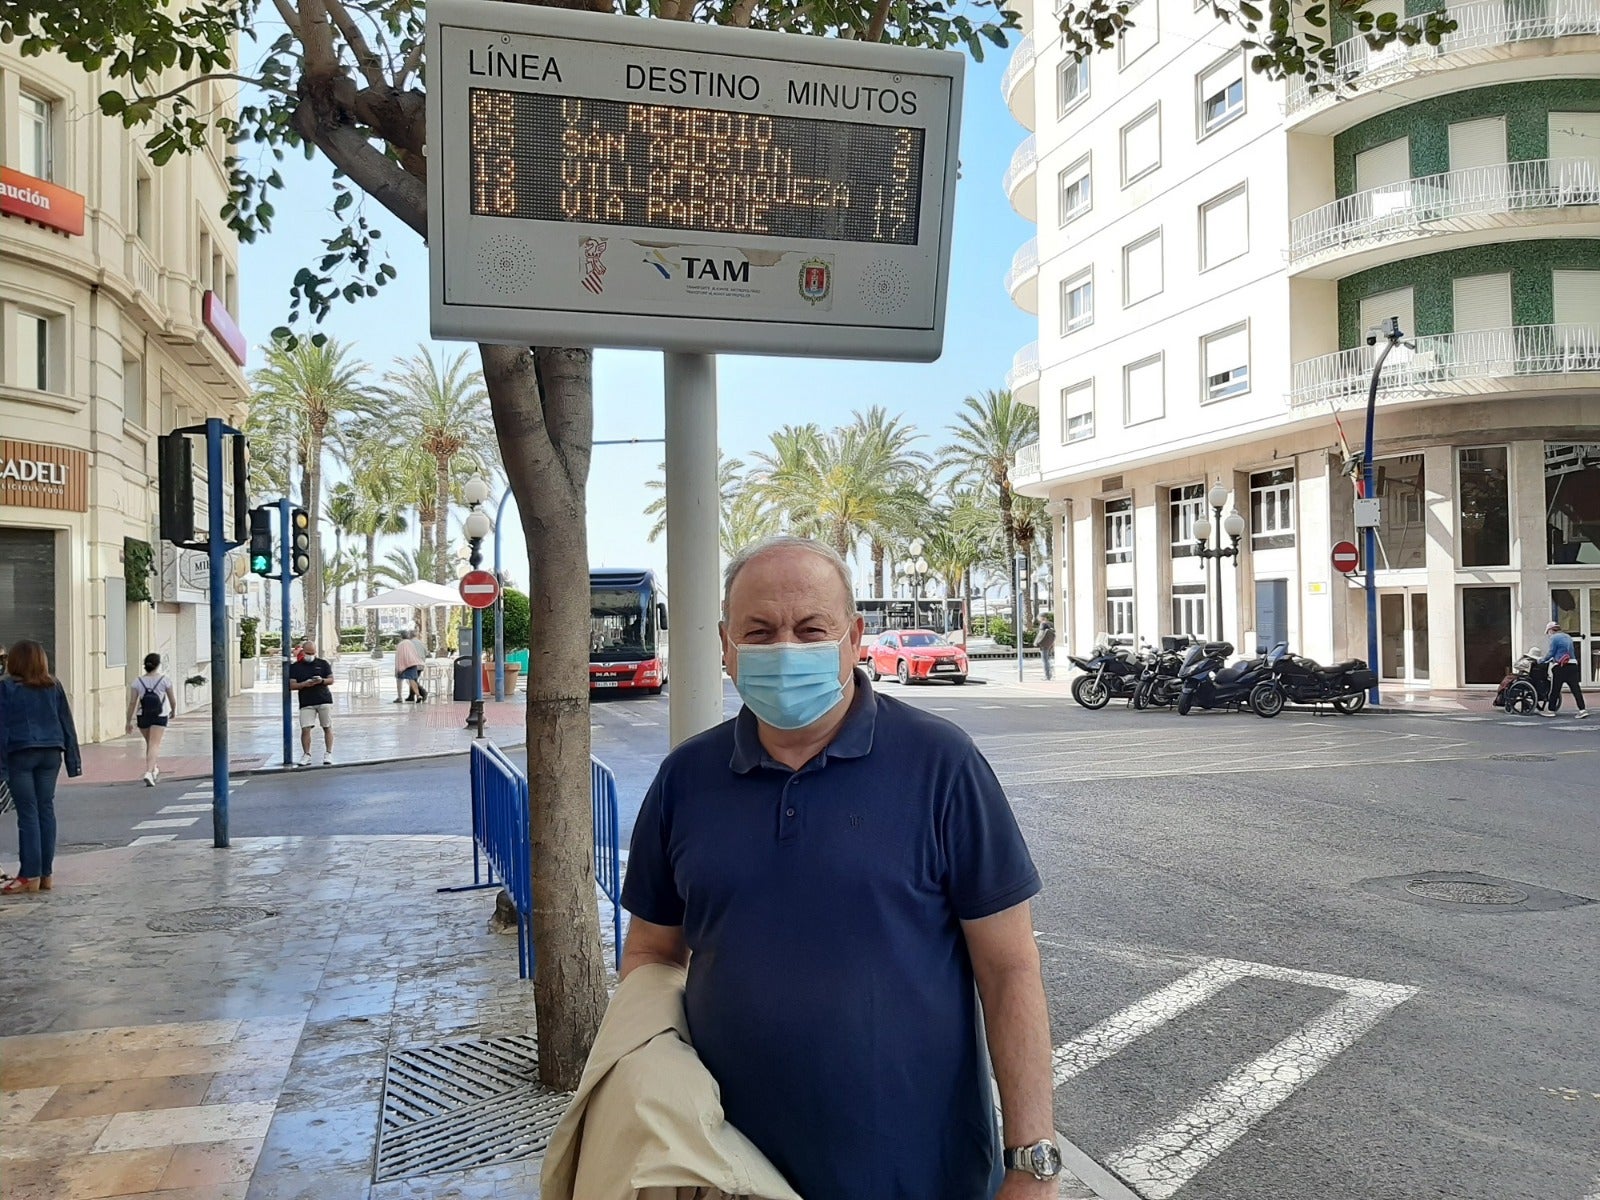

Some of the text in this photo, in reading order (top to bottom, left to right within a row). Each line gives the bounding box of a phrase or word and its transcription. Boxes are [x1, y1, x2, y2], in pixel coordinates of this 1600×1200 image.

[468, 44, 918, 116] LÍNEA DESTINO MINUTOS
[628, 104, 774, 144] REMEDIO
[894, 127, 912, 155] 3
[477, 153, 910, 212] 13 VILLAFRANQUEZA 12
[562, 129, 626, 162] SAN
[649, 137, 792, 174] AGUSTIN
[892, 156, 911, 184] 5
[562, 189, 624, 221] VIA
[647, 196, 770, 232] PARQUE
[872, 212, 907, 240] 17
[680, 256, 751, 283] TAM
